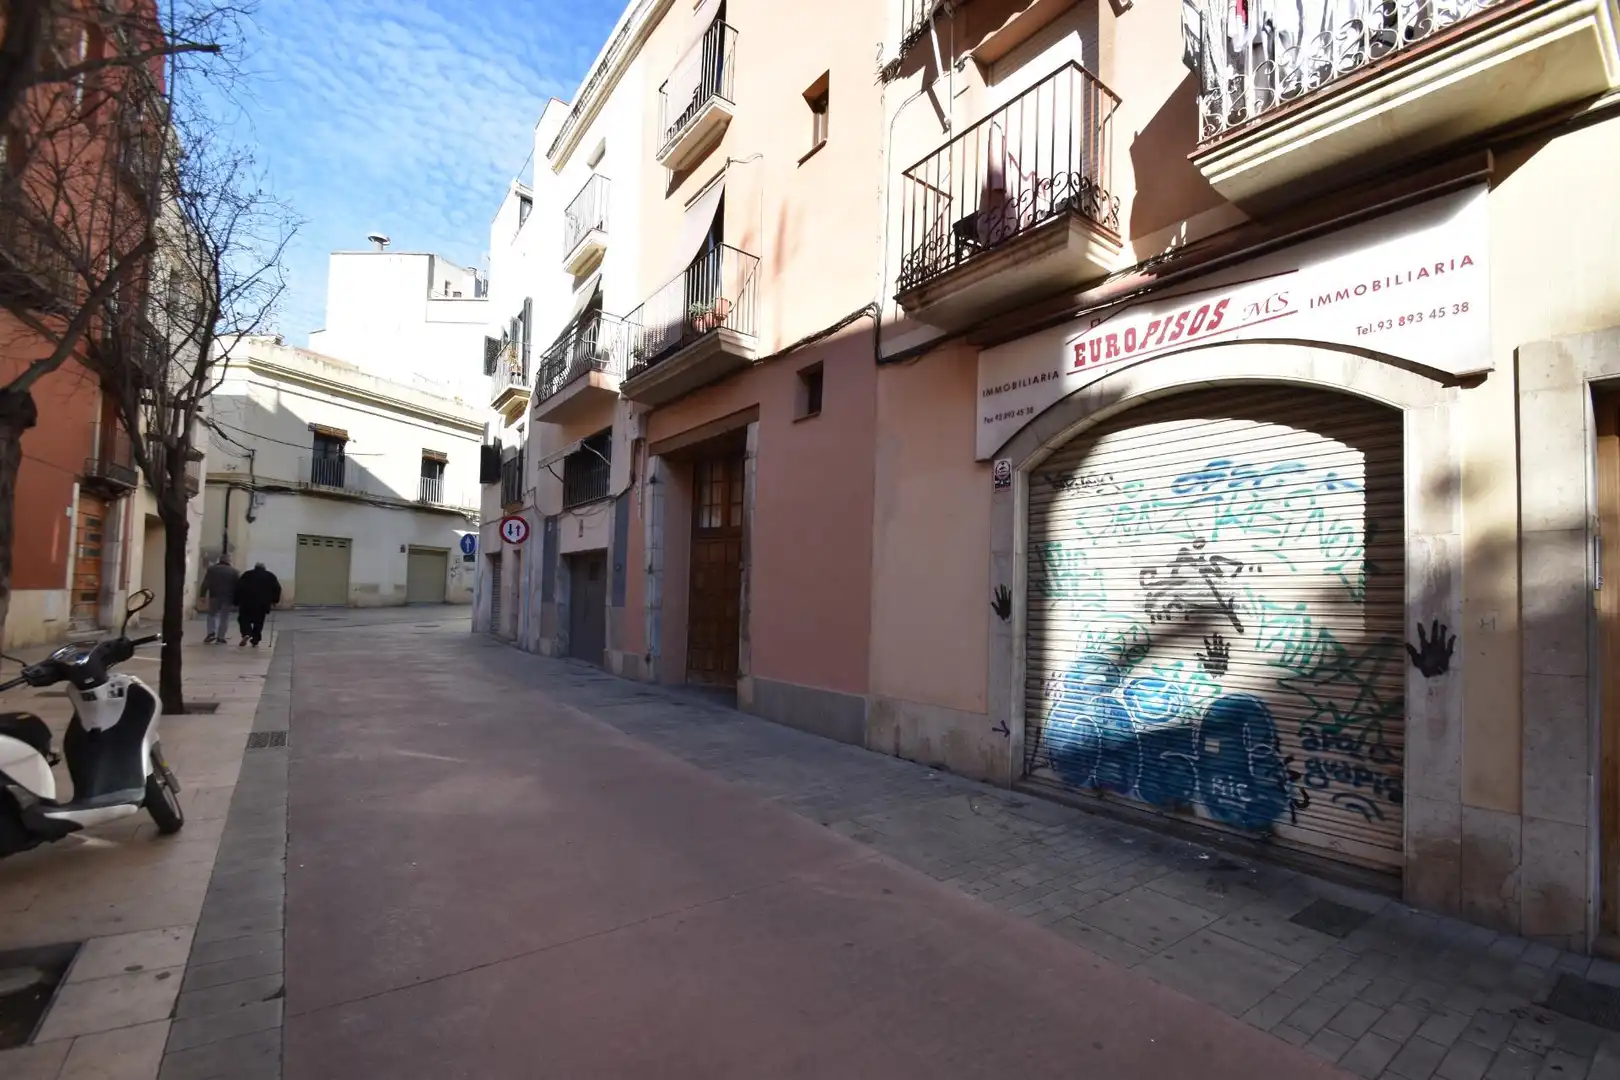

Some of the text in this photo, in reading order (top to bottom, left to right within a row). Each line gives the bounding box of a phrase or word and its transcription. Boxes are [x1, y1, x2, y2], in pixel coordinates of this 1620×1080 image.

[1309, 255, 1474, 309] IMMOBILIARIA
[1074, 291, 1290, 368] EUROPISOS MS
[1398, 312, 1424, 327] 893
[1429, 306, 1446, 320] 45
[1452, 301, 1470, 315] 38
[982, 370, 1059, 398] IMMOBILIARIA
